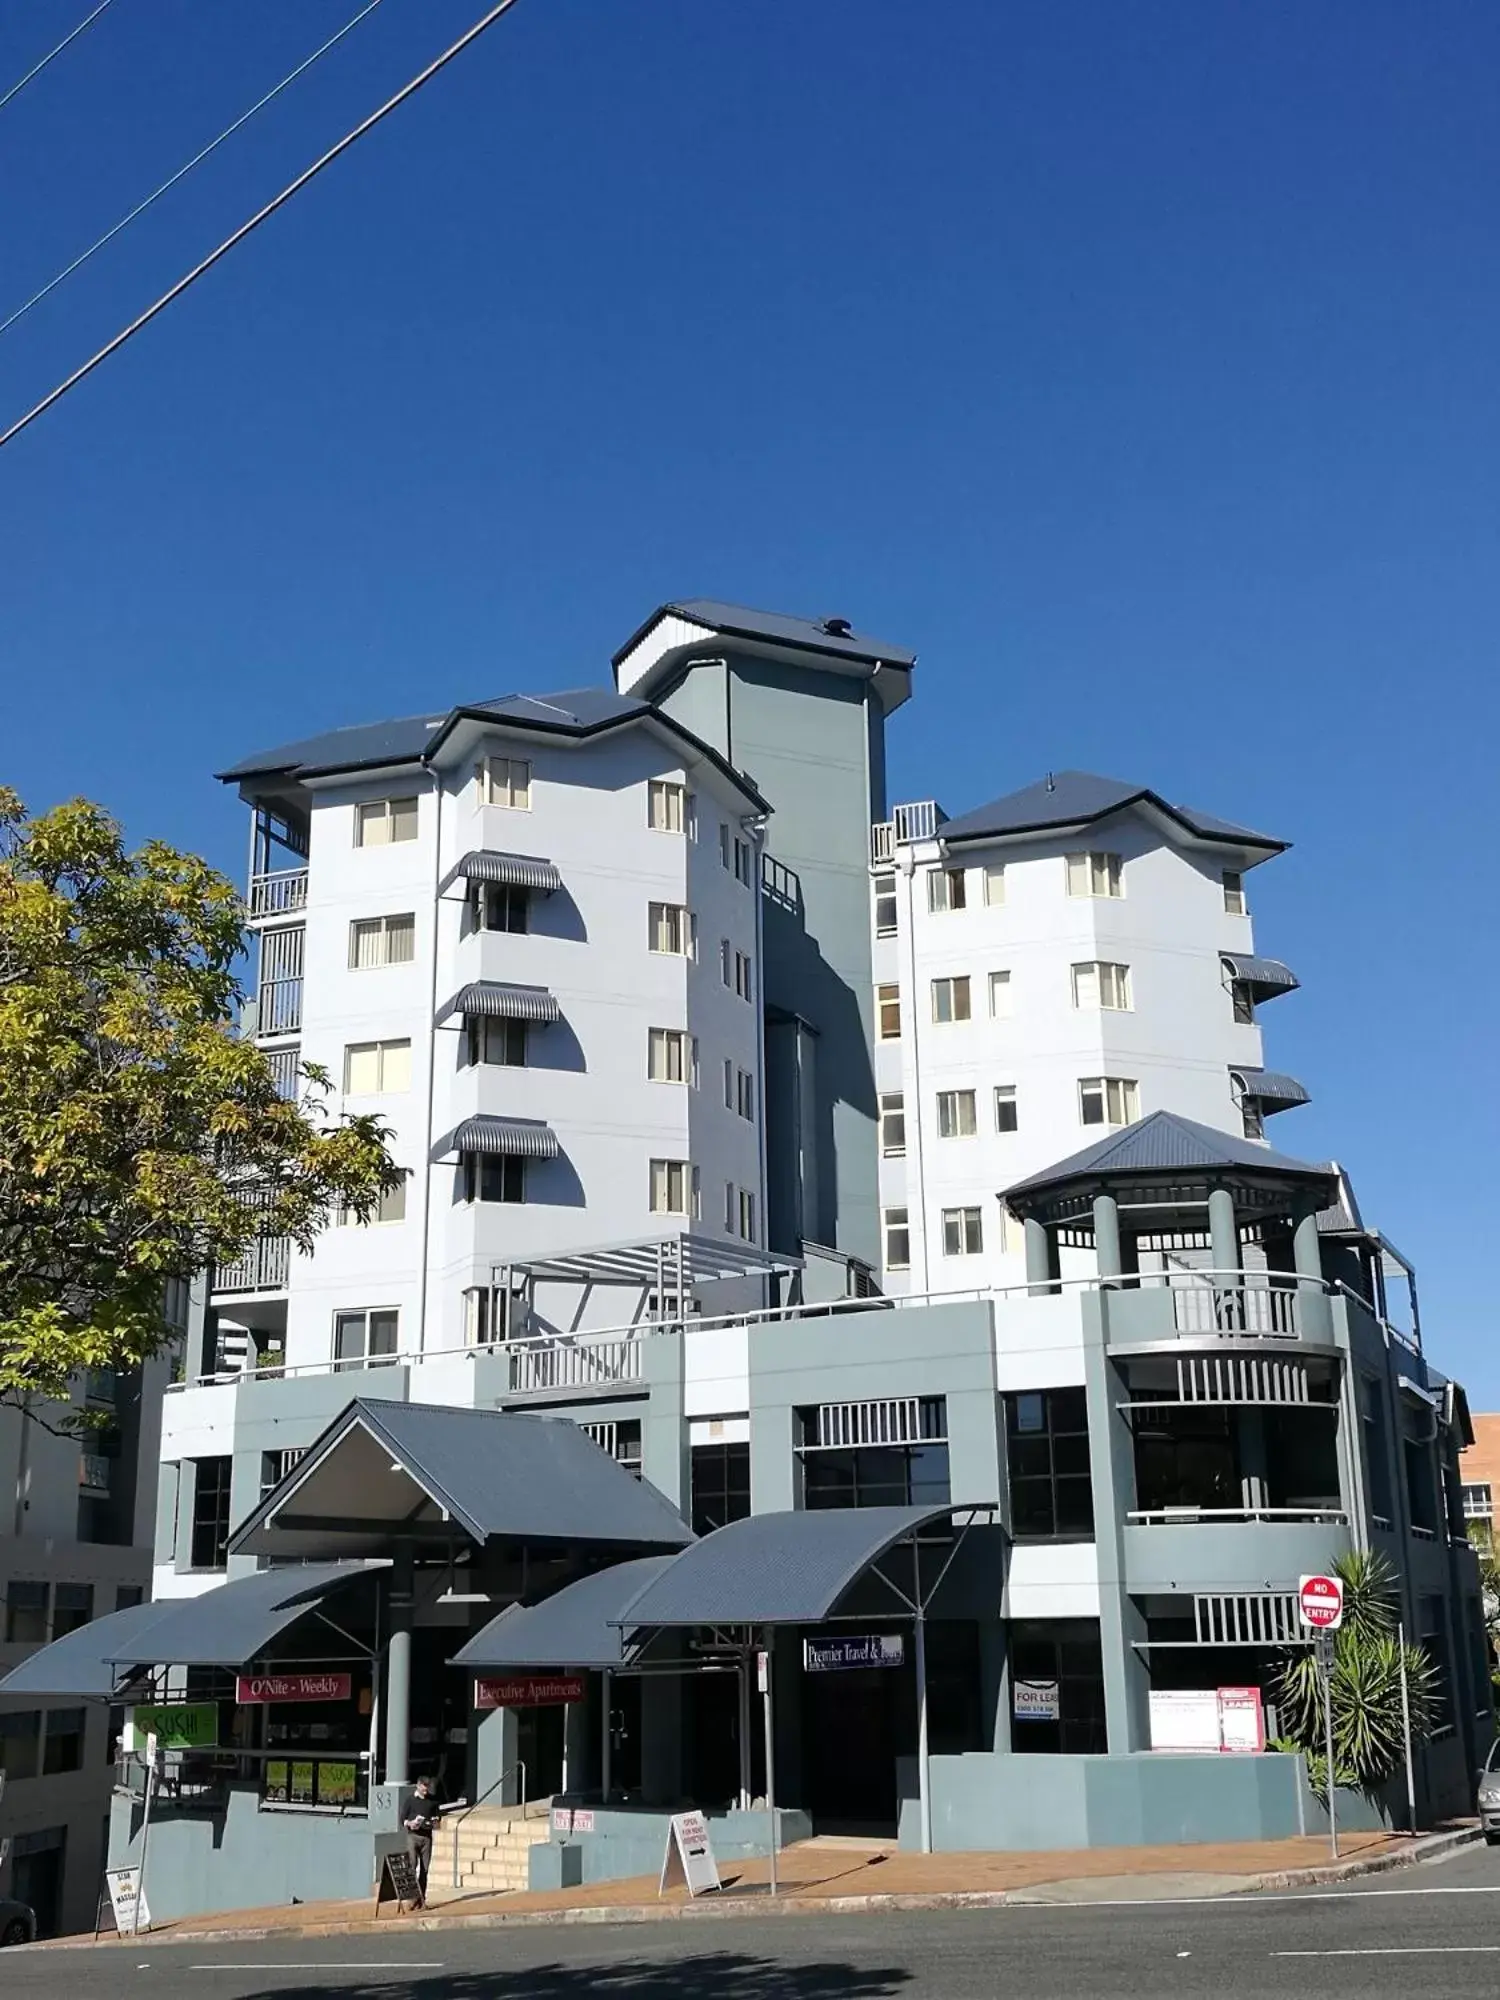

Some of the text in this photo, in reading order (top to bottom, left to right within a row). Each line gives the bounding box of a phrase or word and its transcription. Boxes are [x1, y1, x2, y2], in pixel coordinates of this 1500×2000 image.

[1313, 1583, 1328, 1594] NO
[1305, 1607, 1336, 1619] ENTRY
[808, 1644, 842, 1663] Premier
[844, 1643, 869, 1661] Travel
[870, 1643, 879, 1660] &
[250, 1680, 289, 1696] O'Nite
[300, 1678, 339, 1697] Weekly
[479, 1681, 581, 1702] Executive Apartments
[1016, 1692, 1037, 1702] FOR
[154, 1712, 198, 1738] SUSHI
[376, 1792, 392, 1810] 83
